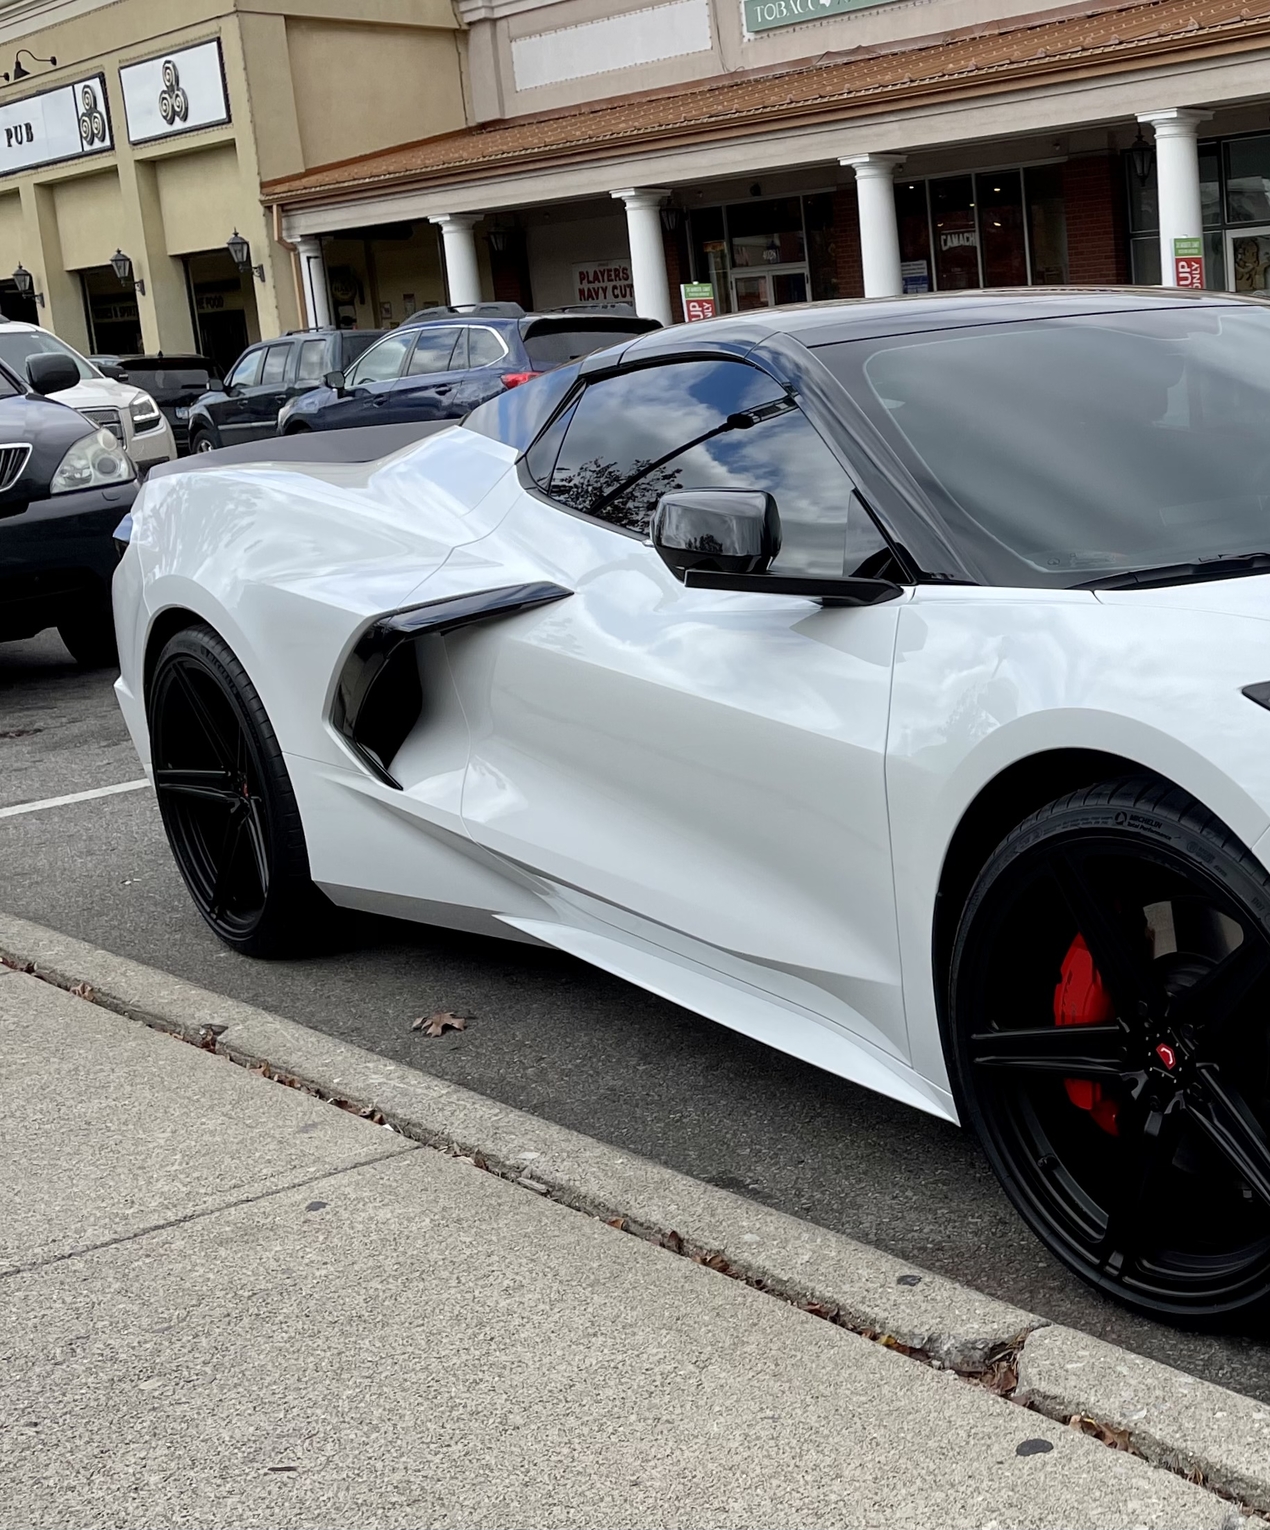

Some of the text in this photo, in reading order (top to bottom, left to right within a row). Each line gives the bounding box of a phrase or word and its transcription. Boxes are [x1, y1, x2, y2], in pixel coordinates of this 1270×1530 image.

[4, 122, 34, 147] PUB
[578, 265, 630, 285] PLAYER'S
[578, 283, 634, 302] NAVY CUT
[702, 302, 713, 319] NLY
[1129, 814, 1163, 829] MICHELIN
